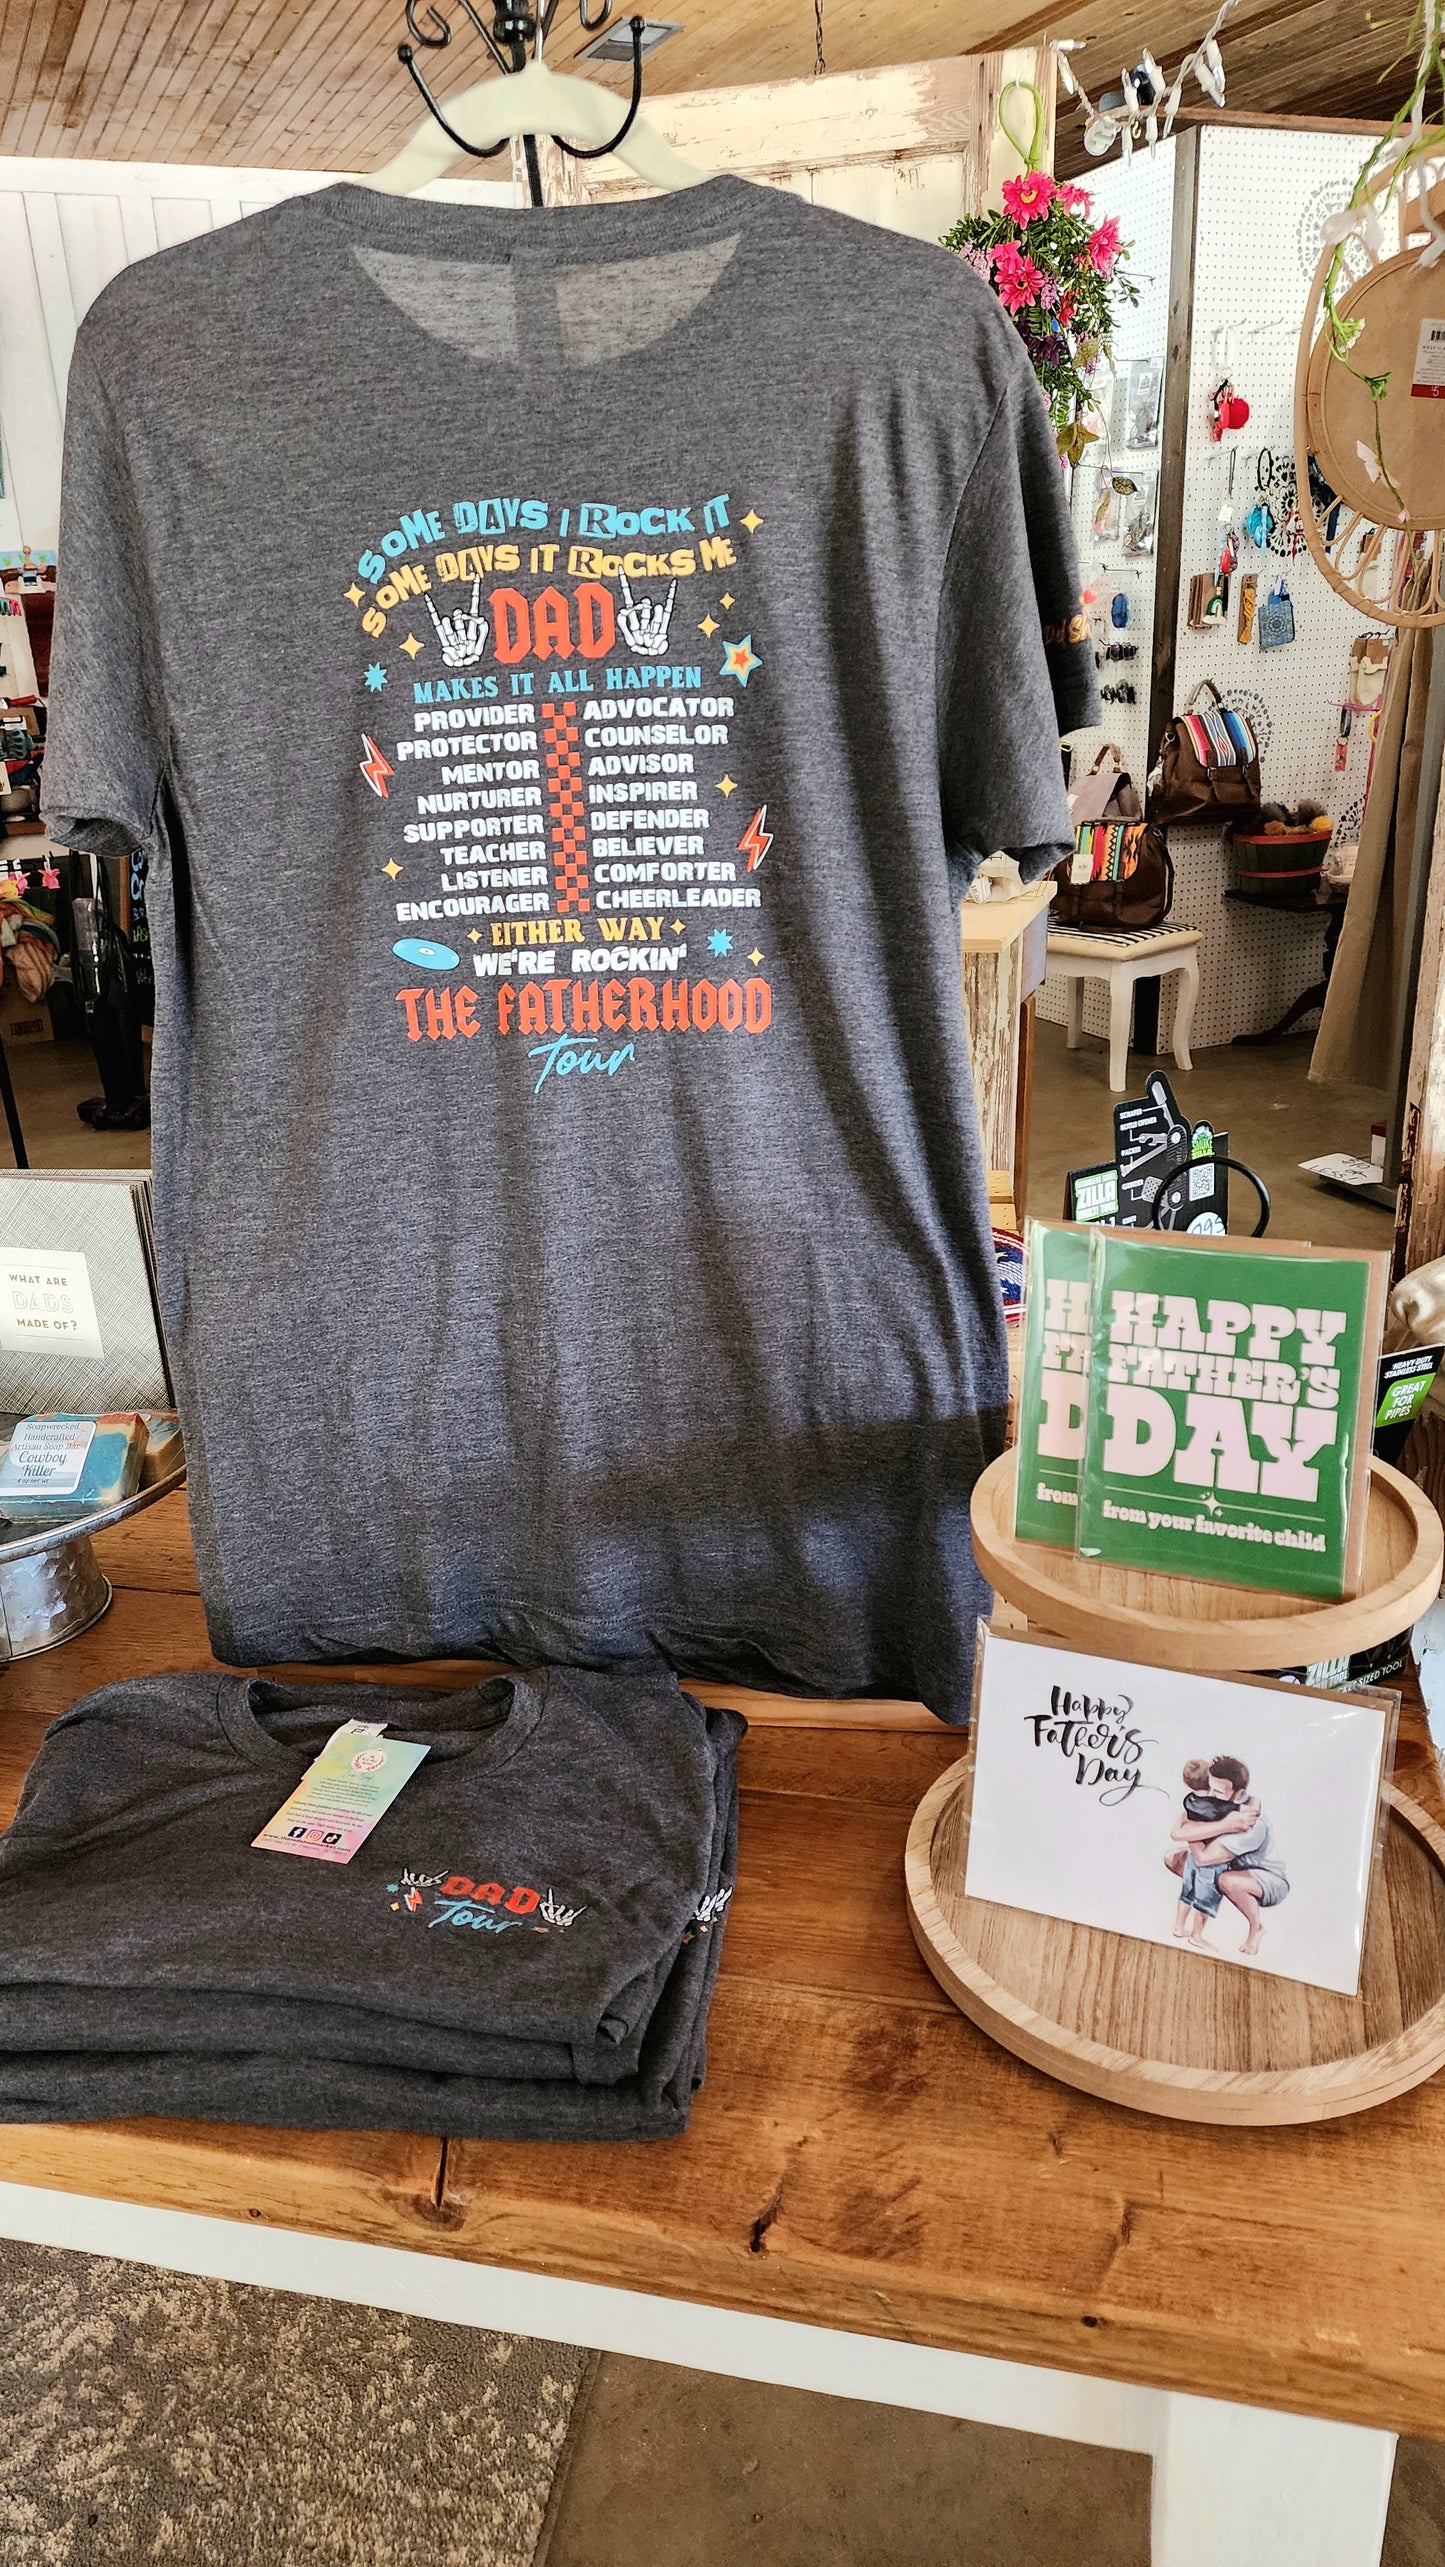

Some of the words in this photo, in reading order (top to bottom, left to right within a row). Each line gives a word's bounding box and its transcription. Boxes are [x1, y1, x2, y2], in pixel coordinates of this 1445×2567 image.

[453, 498, 548, 534] DAYS
[559, 508, 570, 538] I
[579, 502, 696, 538] ROCK
[702, 493, 731, 535] IT
[435, 544, 519, 582] DAYS
[530, 544, 560, 574] IT
[567, 545, 697, 580] ROCKS
[698, 536, 737, 572] ME
[488, 582, 616, 664] DAD
[413, 676, 499, 704] MAKES
[511, 672, 534, 696] IT
[548, 670, 593, 694] ALL
[606, 665, 702, 690] HAPPEN
[413, 703, 535, 732] PROVIDER
[583, 697, 735, 721] ADVOCATOR
[397, 731, 538, 761] PROTECTOR
[584, 724, 729, 748] COUNSELOR
[441, 759, 539, 786] MENTOR
[588, 753, 695, 777] ADVISOR
[417, 786, 542, 815] NURTURER
[588, 780, 699, 804] INSPIRER
[402, 814, 545, 844] SUPPORTER
[590, 808, 710, 831] DEFENDER
[440, 840, 547, 866] TEACHER
[592, 835, 705, 857] BELIEVER
[440, 866, 549, 892] LISTENER
[594, 861, 737, 883] COMFORTER
[396, 892, 550, 922] ENCOURAGER
[596, 888, 762, 910] CHEERLEADER
[490, 918, 586, 947] EITHER
[598, 916, 668, 942] WAY
[472, 948, 556, 978] WE'RE
[570, 943, 688, 973] ROCKIN'
[396, 985, 482, 1042] THE
[497, 977, 773, 1036] FATHERHOOD
[528, 1033, 635, 1094] Tour
[1077, 1181, 1115, 1210] ZILLA
[9, 1274, 40, 1284] WHAT
[47, 1277, 68, 1286] ARE
[12, 1291, 74, 1314] DADS
[16, 1318, 49, 1329] MADE
[1110, 1290, 1348, 1367] HAPPY
[1107, 1343, 1341, 1409] FATHER'S
[1392, 1381, 1427, 1397] GREAT
[1384, 1405, 1412, 1420] PIPES
[1393, 1394, 1414, 1408] FOR
[24, 1433, 75, 1441] Handcrafted
[26, 1423, 80, 1431] Soapwrecked
[43, 1443, 63, 1451] Soap
[1103, 1383, 1338, 1502] DAY
[19, 1451, 67, 1466] Cowboy
[22, 1464, 56, 1477] Killer
[1036, 1482, 1078, 1506] from
[1103, 1499, 1147, 1524] from
[1148, 1510, 1195, 1530] your
[1196, 1514, 1273, 1544] favorite
[1274, 1530, 1327, 1552] child
[1359, 1669, 1380, 1685] SIZED
[1382, 1658, 1403, 1675] TOOL
[1050, 1685, 1134, 1724] Happy
[1075, 1752, 1170, 1806] Day
[439, 1876, 541, 1914] DAD
[428, 1900, 523, 1934] Tour
